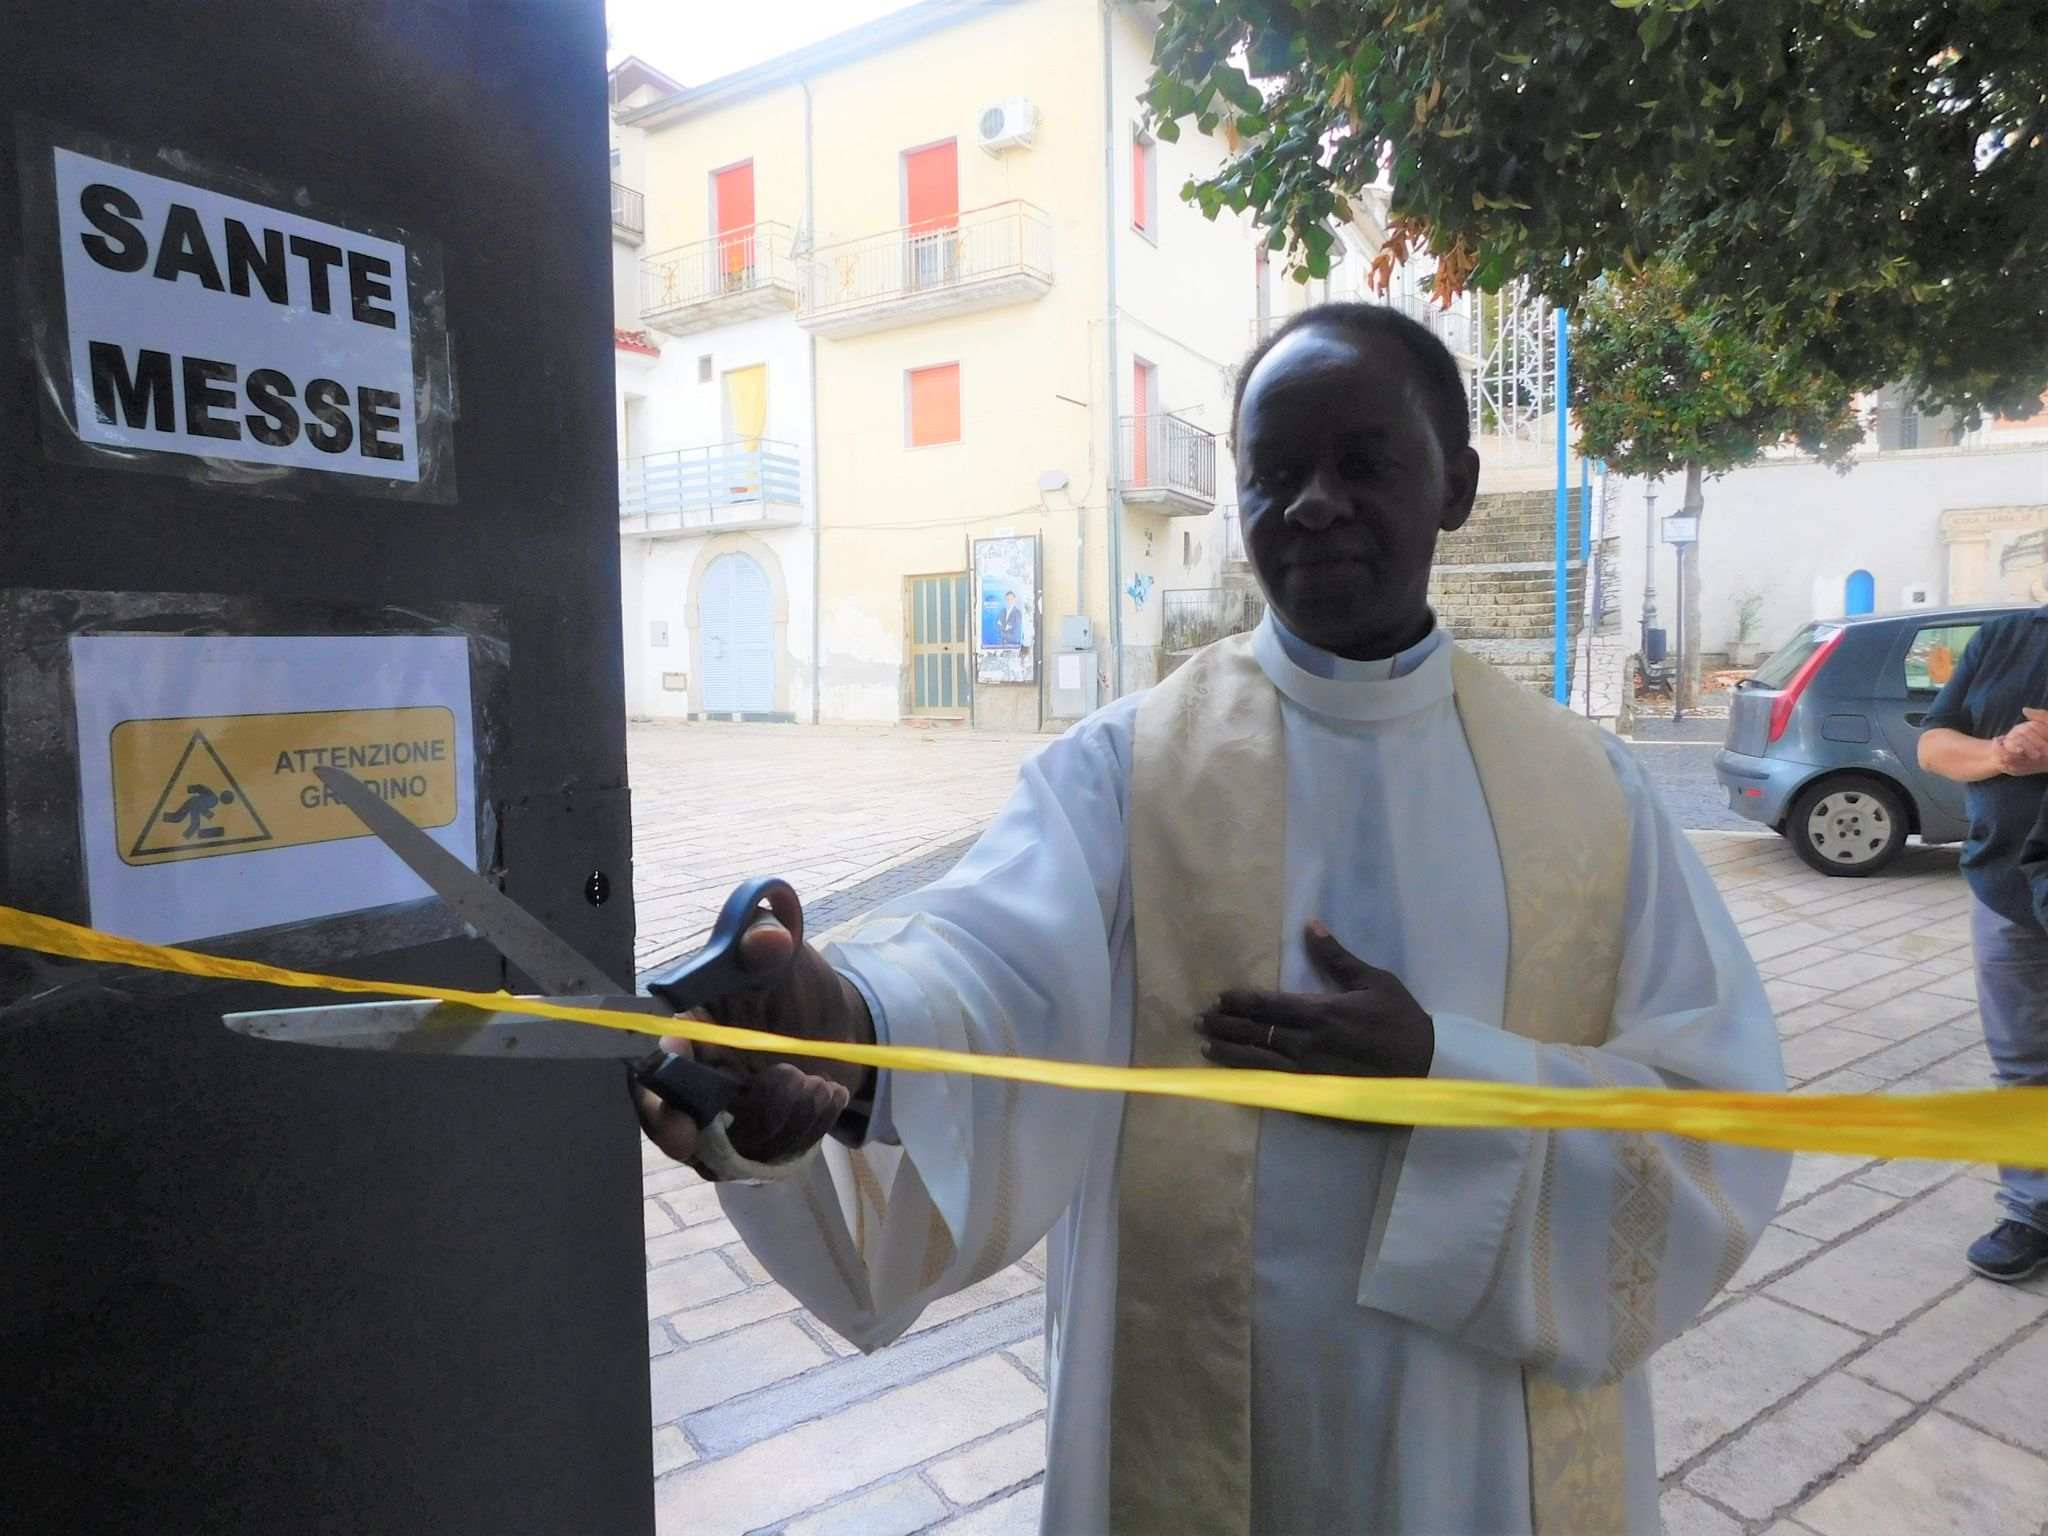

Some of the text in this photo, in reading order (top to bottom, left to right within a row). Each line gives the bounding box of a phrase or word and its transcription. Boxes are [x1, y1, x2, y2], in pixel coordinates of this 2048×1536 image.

[80, 184, 396, 329] SANTE
[89, 340, 405, 461] MESSE
[274, 739, 446, 775] ATTENZIONE
[300, 775, 427, 809] GRDINO
